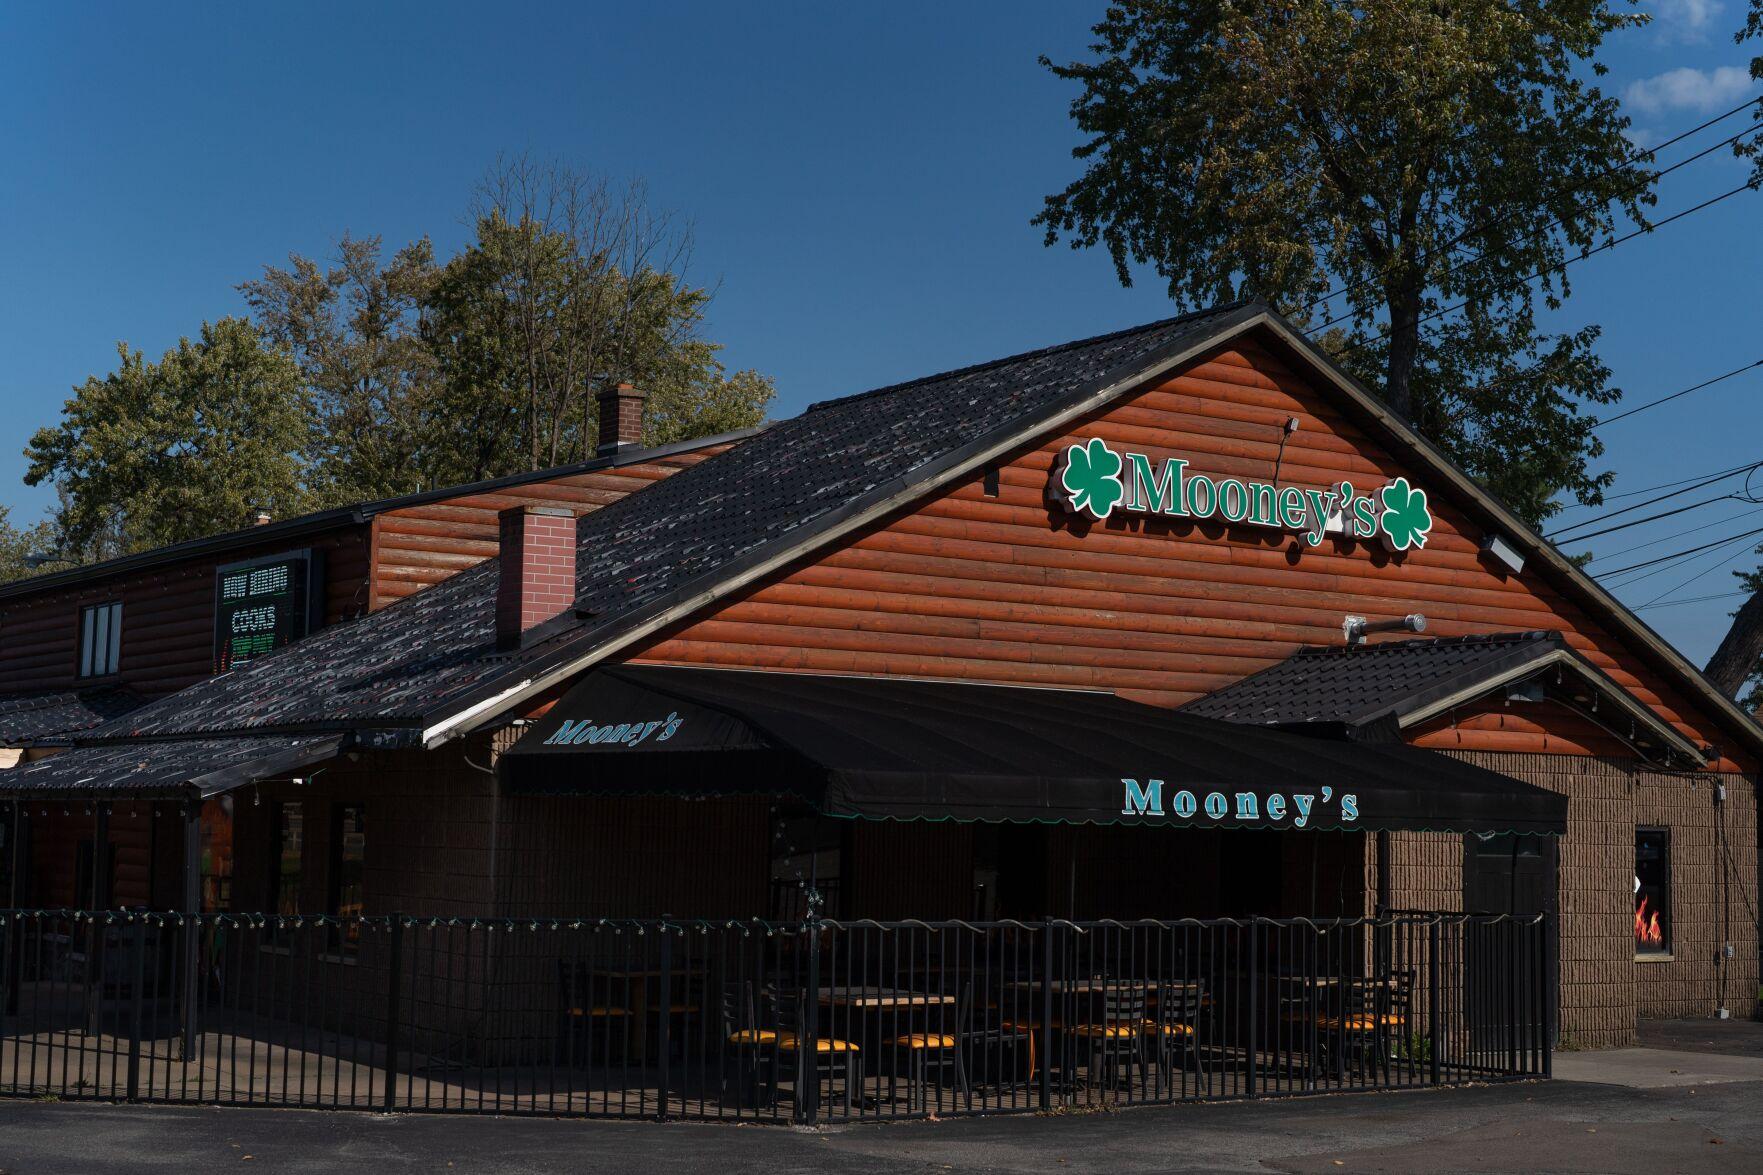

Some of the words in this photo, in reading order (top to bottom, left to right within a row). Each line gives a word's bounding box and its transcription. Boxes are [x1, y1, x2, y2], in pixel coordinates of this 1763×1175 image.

[1125, 452, 1376, 547] Mooney's
[223, 575, 247, 598] NOW
[249, 566, 288, 596] HIRING
[232, 606, 276, 633] COOKS
[543, 711, 683, 747] Mooney's
[1120, 778, 1359, 827] Mooney's
